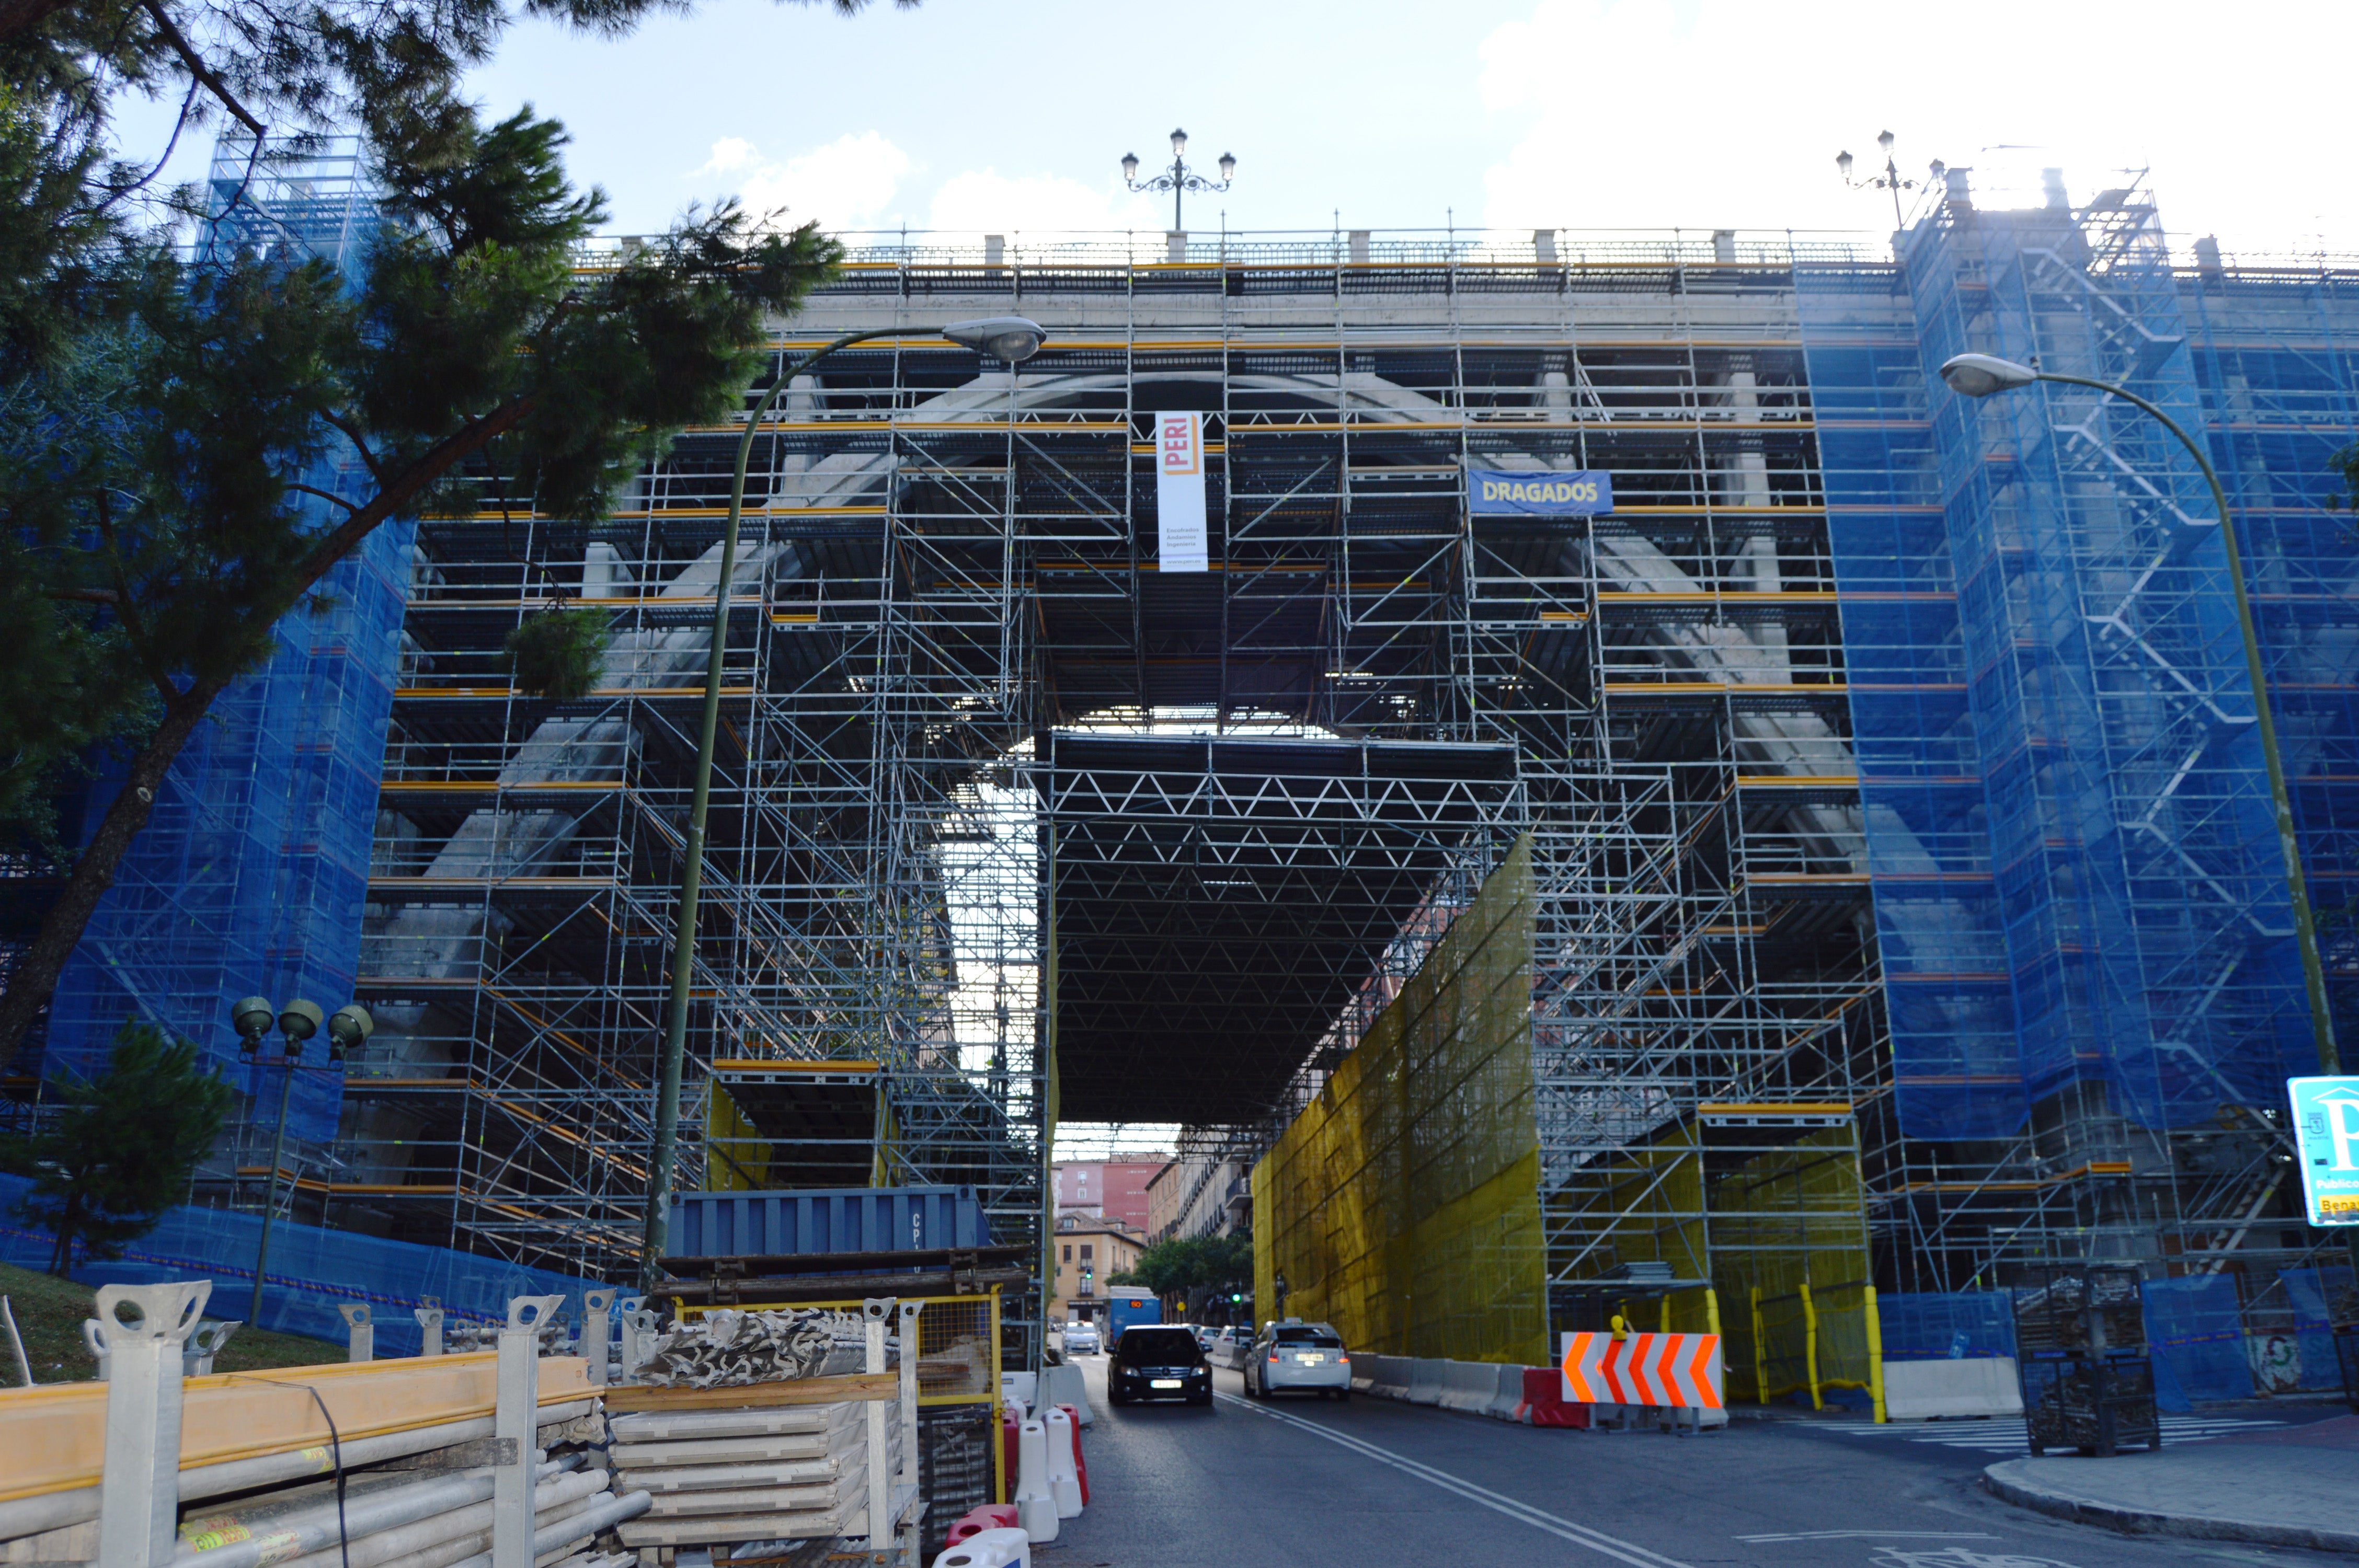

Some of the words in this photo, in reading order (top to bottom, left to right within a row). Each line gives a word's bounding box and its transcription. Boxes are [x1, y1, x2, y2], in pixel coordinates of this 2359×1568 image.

[1164, 418, 1188, 466] PERI
[1483, 481, 1598, 503] DRAGADOS
[2321, 1200, 2359, 1210] Bena
